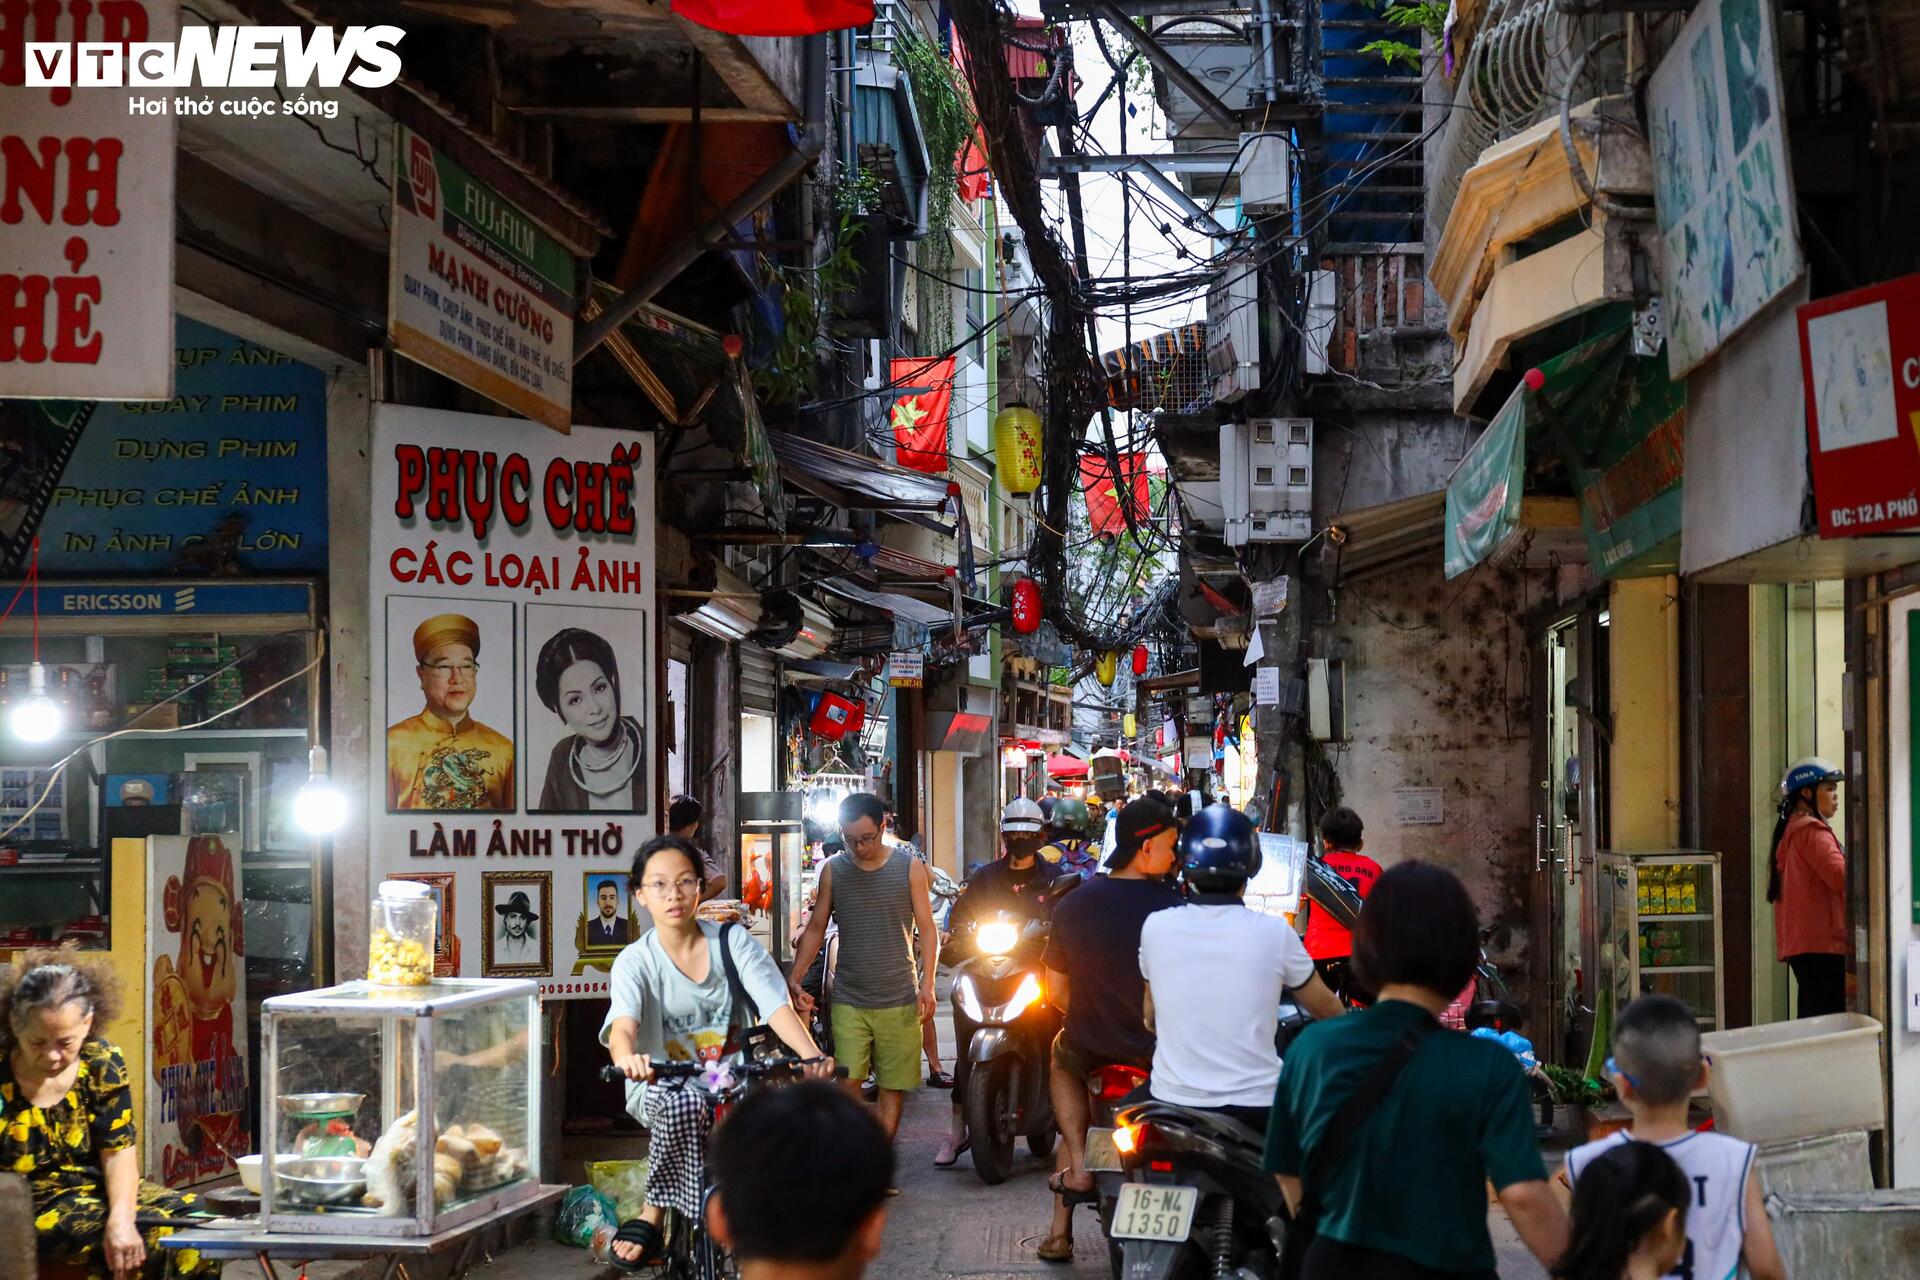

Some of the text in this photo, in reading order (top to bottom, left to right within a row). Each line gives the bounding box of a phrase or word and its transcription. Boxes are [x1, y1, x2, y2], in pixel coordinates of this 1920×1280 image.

[427, 240, 490, 308] MẠNH
[492, 284, 554, 345] CƯỜNG
[220, 395, 298, 413] PHIM
[114, 438, 298, 463] DỰNG PHIM
[52, 481, 300, 510] PHỤC CHẾ ẢNH
[394, 441, 642, 541] PHỤC CHẾ
[1857, 503, 1885, 524] 12A
[1886, 489, 1918, 520] PHỐ
[63, 532, 96, 552] IN
[104, 528, 173, 551] ẢNH
[237, 529, 302, 551] LỚN
[389, 540, 642, 595] CÁC LOẠI ẢNH
[63, 594, 162, 611] ERICSSON
[409, 819, 623, 857] LÀM ẢNH THỜ
[1132, 1189, 1182, 1213] 16-N4
[1127, 1213, 1180, 1236] 1350
